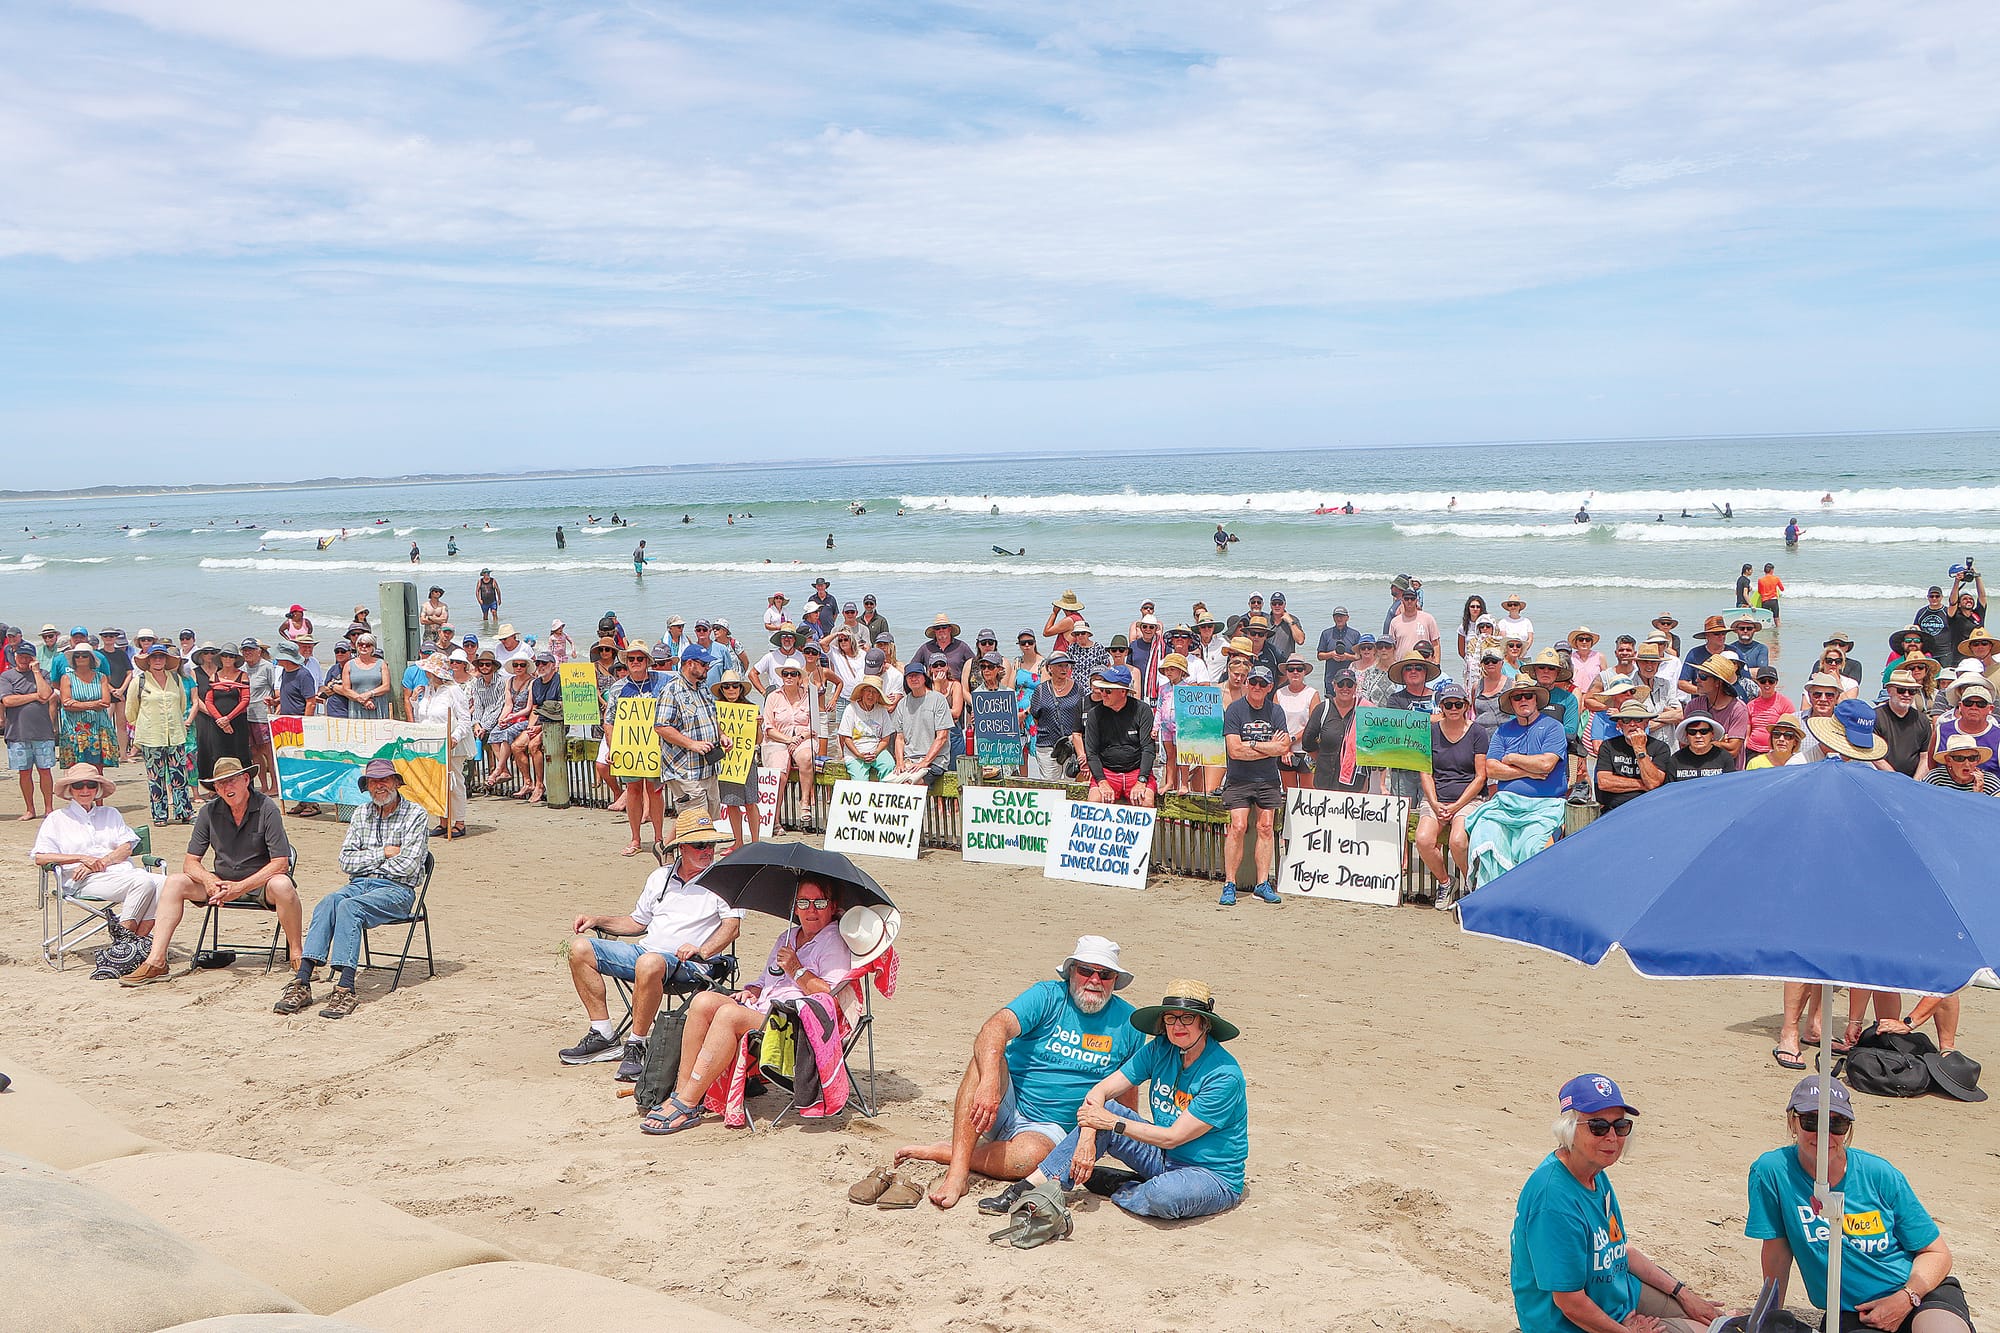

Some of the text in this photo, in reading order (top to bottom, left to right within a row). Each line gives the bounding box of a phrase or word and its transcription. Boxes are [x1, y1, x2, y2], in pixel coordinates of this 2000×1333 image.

[976, 694, 1013, 714] Coastal
[1178, 688, 1220, 704] Save our
[618, 701, 656, 721] SAV
[719, 707, 754, 723] WAVE
[1188, 703, 1212, 716] coast
[1364, 712, 1428, 731] Save our Coast
[980, 742, 996, 753] our
[1362, 734, 1427, 753] Save our Homes
[611, 751, 659, 771] COAS
[841, 792, 922, 811] NO RETREAT
[992, 789, 1039, 808] SAVE
[1291, 790, 1330, 825] Adapt
[1328, 802, 1345, 817] and
[1345, 796, 1391, 823] Retreat
[848, 810, 909, 827] WE WANT
[1115, 807, 1152, 827] SAVED
[834, 826, 875, 843] ACTION
[967, 832, 1049, 853] BEACH and DUNE
[1071, 822, 1139, 845] APOLLO BAY
[1303, 828, 1369, 856] Tell 'em
[1068, 839, 1132, 859] NOW SAVE
[1290, 861, 1399, 892] They're Dreamin'
[1086, 1037, 1110, 1049] Vote 1
[1846, 1215, 1879, 1232] Vote 1
